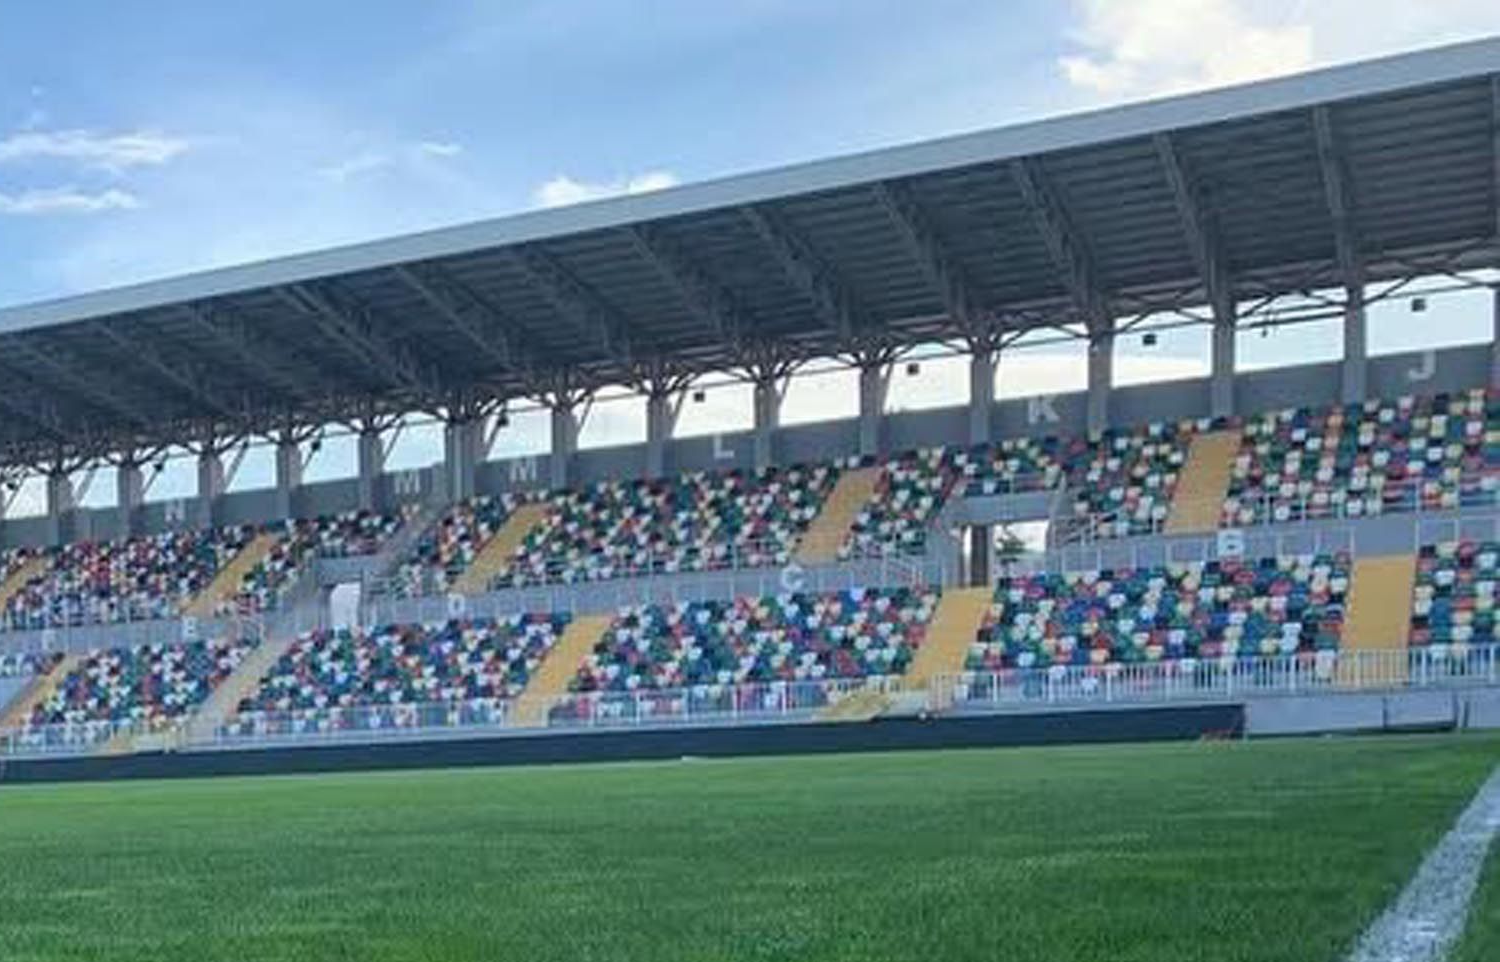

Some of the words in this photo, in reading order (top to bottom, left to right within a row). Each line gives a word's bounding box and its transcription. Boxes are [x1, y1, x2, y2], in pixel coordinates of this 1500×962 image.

[1409, 350, 1437, 380] J
[1028, 396, 1060, 424] K
[714, 433, 735, 459] L
[395, 471, 420, 494] M
[510, 458, 537, 482] M
